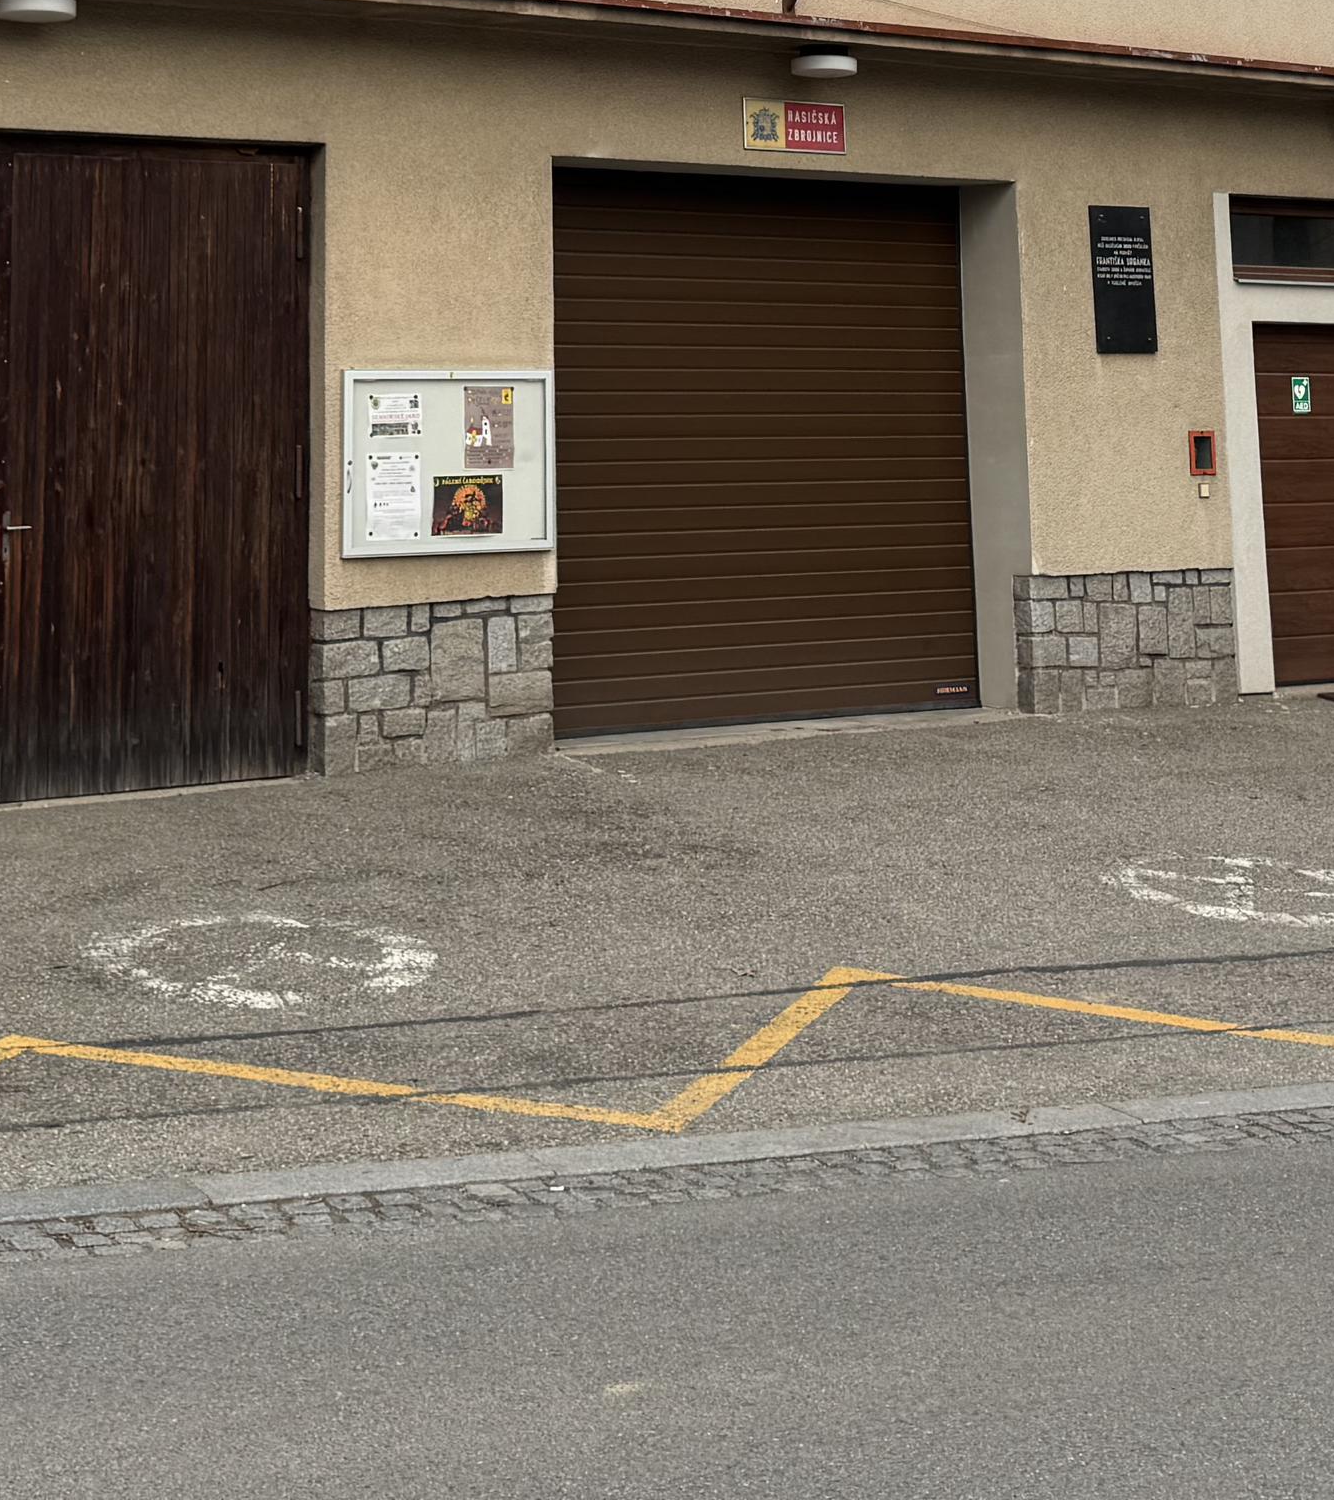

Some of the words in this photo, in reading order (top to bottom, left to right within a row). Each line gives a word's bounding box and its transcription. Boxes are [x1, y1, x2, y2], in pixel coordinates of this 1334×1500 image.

[787, 109, 837, 125] HASIČSKÁ
[787, 128, 838, 144] ZBROJNICE
[1295, 402, 1309, 410] AED
